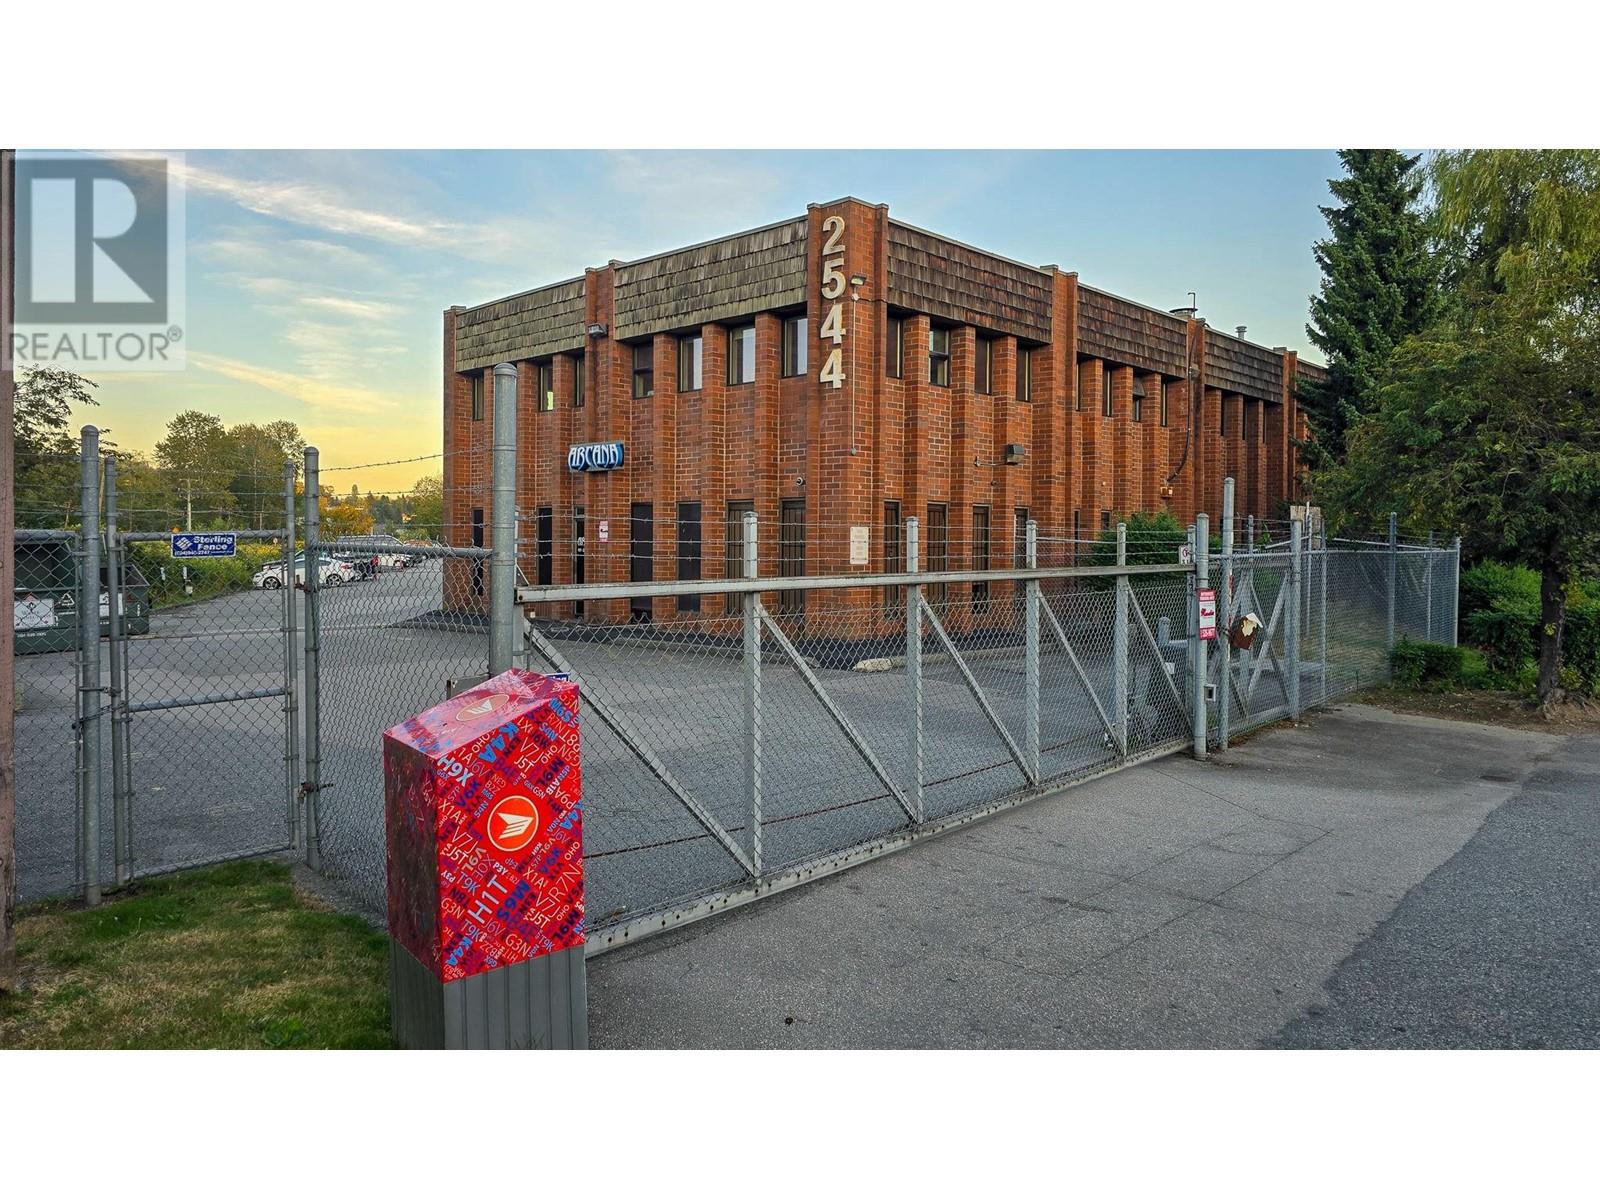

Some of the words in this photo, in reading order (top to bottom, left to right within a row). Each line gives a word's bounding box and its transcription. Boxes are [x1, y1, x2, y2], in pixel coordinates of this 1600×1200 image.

[820, 215, 847, 389] 2544
[568, 444, 619, 471] ARCANA
[193, 536, 233, 544] Sterling
[478, 721, 519, 763] K4A
[520, 736, 544, 764] V7J
[437, 756, 474, 787] H9X
[514, 755, 534, 773] J5T
[554, 786, 577, 810] P9A
[438, 799, 461, 823] X1A
[452, 826, 478, 853] V7J
[447, 847, 468, 865] J5T
[461, 848, 487, 871] V9L
[441, 870, 456, 882] P3Y
[493, 862, 508, 875] P3Y
[523, 866, 545, 889] X1A
[457, 871, 481, 896] T9K
[548, 863, 581, 903] R7N
[441, 897, 465, 919] G3N
[467, 874, 508, 924] H1T
[535, 890, 561, 918] V7J
[461, 918, 483, 942] T9K
[530, 911, 551, 929] J5T
[445, 936, 473, 966] K4A
[505, 933, 531, 958] G3N
[538, 933, 555, 952] T9K
